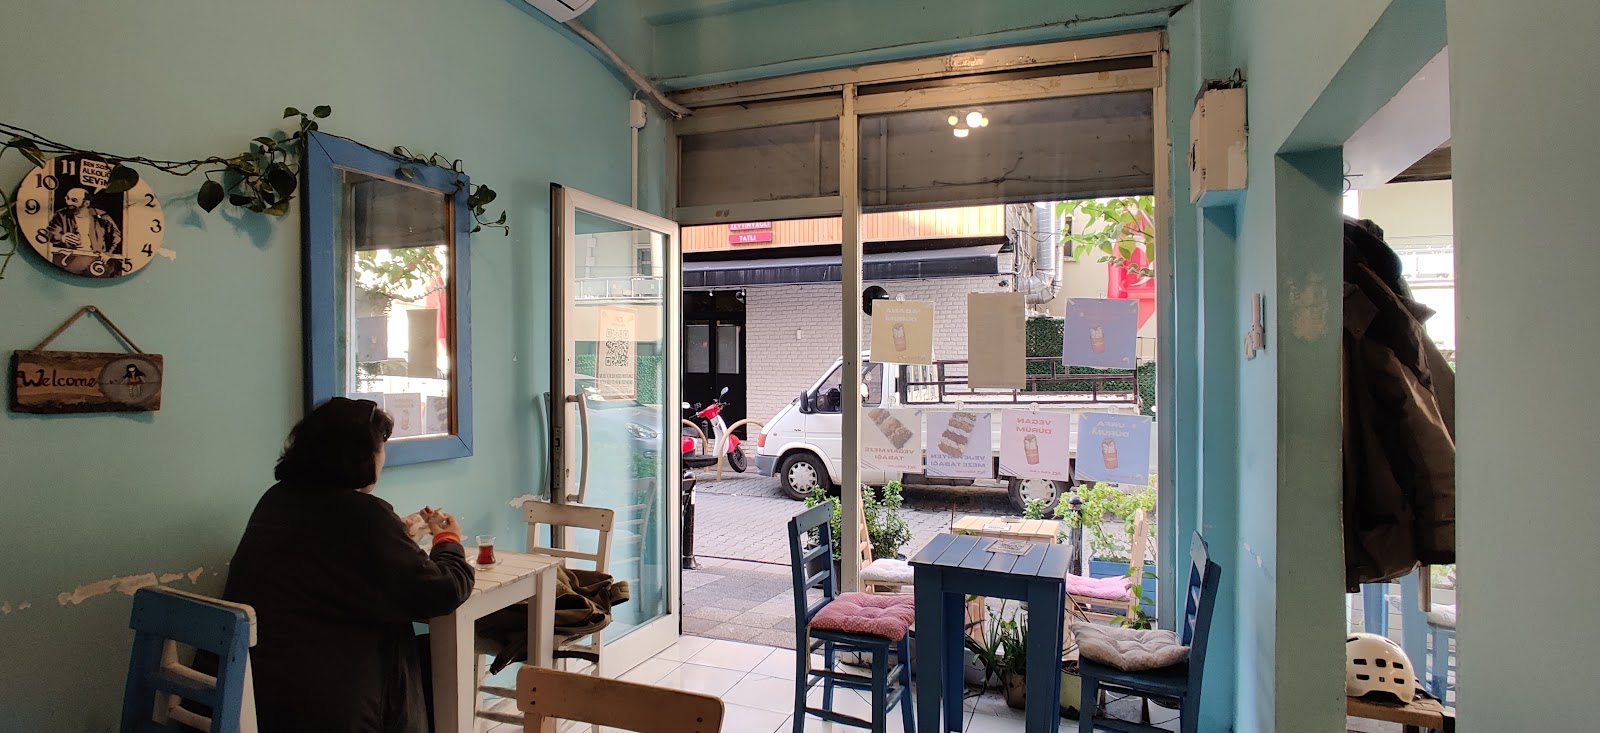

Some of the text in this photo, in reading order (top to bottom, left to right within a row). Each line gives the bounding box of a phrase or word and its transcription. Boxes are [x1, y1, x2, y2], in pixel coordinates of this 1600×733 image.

[61, 159, 76, 176] 11
[83, 160, 95, 168] BEN
[35, 173, 59, 191] 10
[24, 199, 41, 215] 9
[144, 193, 156, 208] 2
[150, 219, 162, 234] 3
[35, 228, 50, 244] 8
[739, 234, 756, 242] TATLI
[58, 250, 74, 266] 7
[141, 243, 153, 257] 4
[89, 260, 105, 276] 6
[121, 258, 133, 272] 5
[17, 368, 98, 387] Welcome
